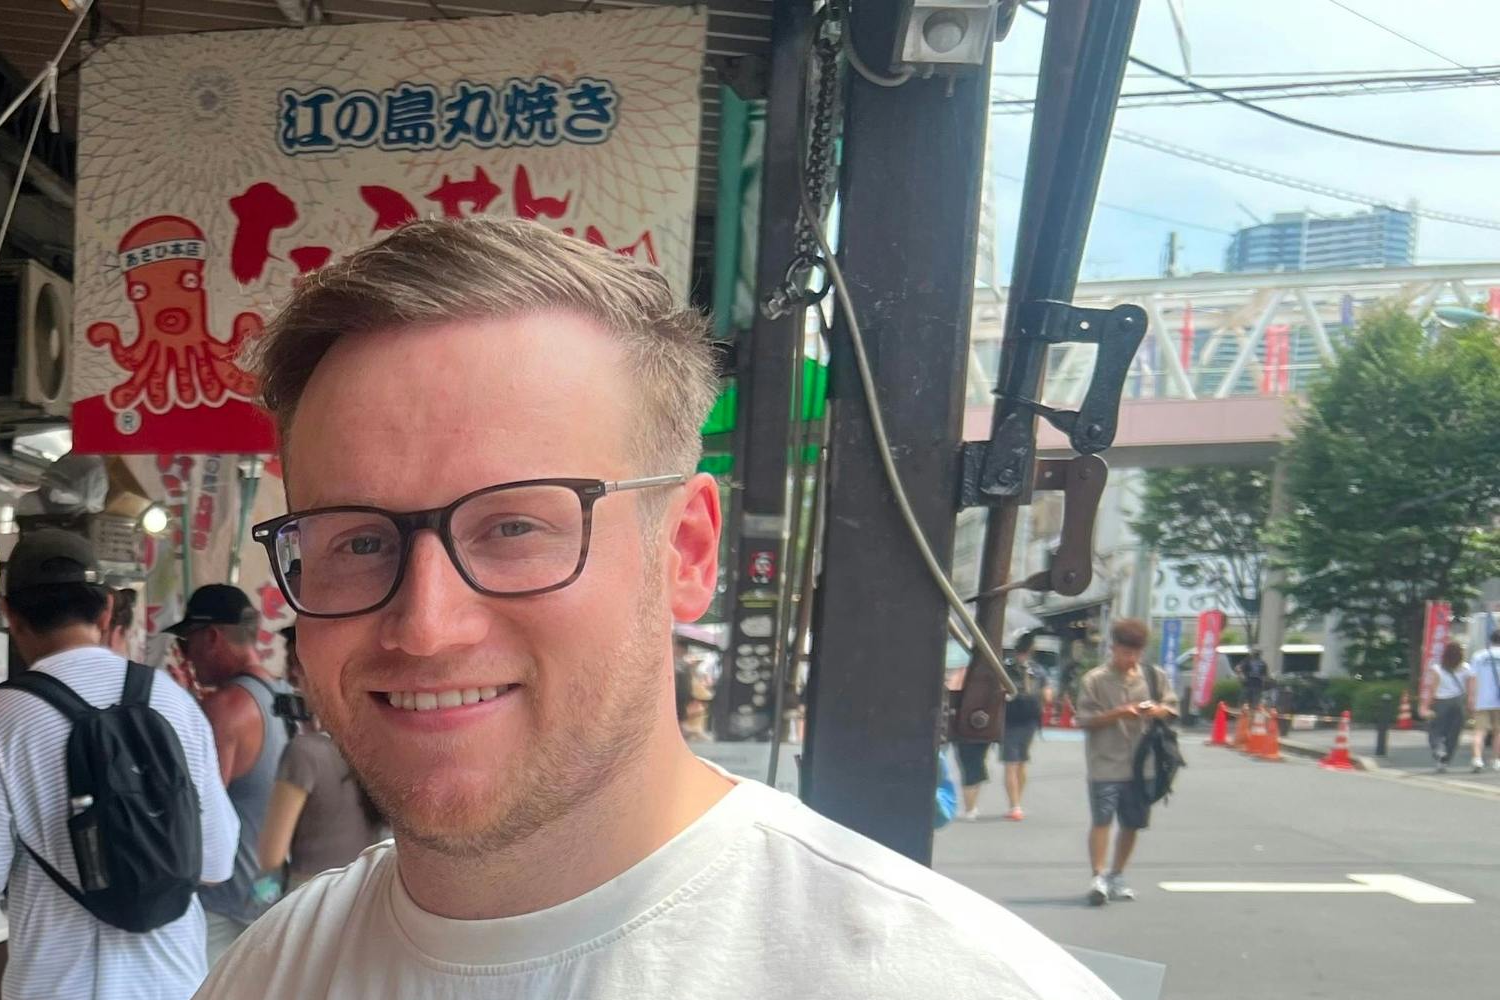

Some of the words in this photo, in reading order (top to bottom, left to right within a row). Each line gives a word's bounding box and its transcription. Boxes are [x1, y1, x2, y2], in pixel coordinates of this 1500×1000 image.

[280, 81, 615, 153] 江の島丸焼き
